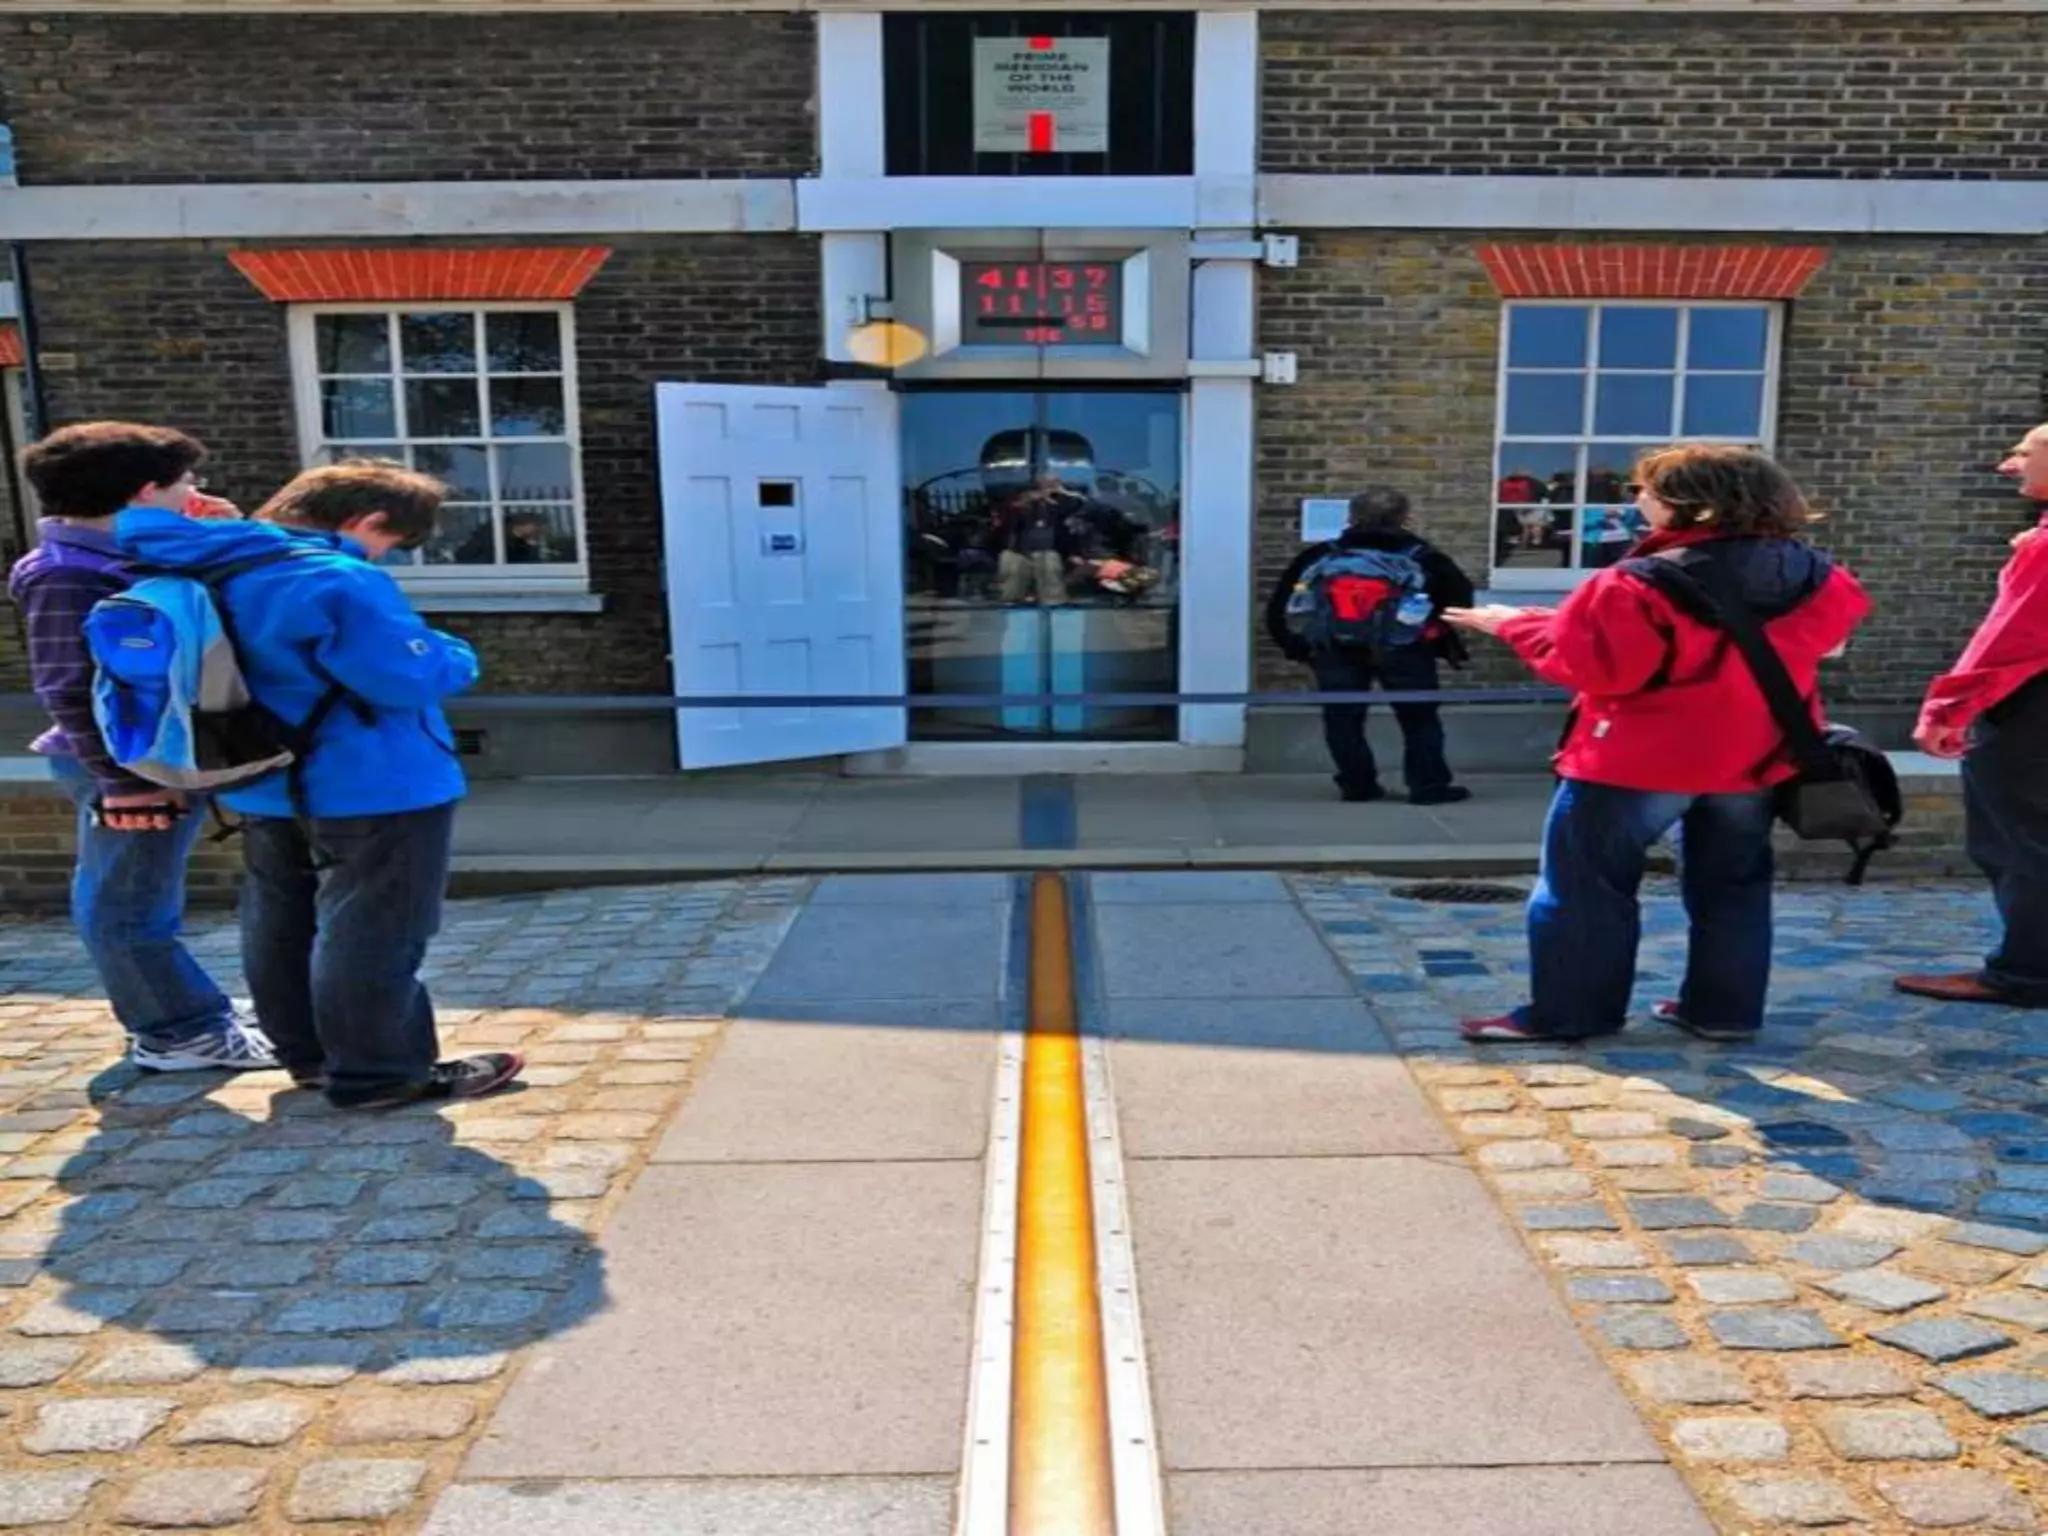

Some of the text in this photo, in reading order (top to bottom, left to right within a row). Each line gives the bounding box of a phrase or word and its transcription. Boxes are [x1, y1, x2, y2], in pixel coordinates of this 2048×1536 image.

[1008, 73, 1074, 82] OF THE
[1006, 84, 1076, 93] WORLD
